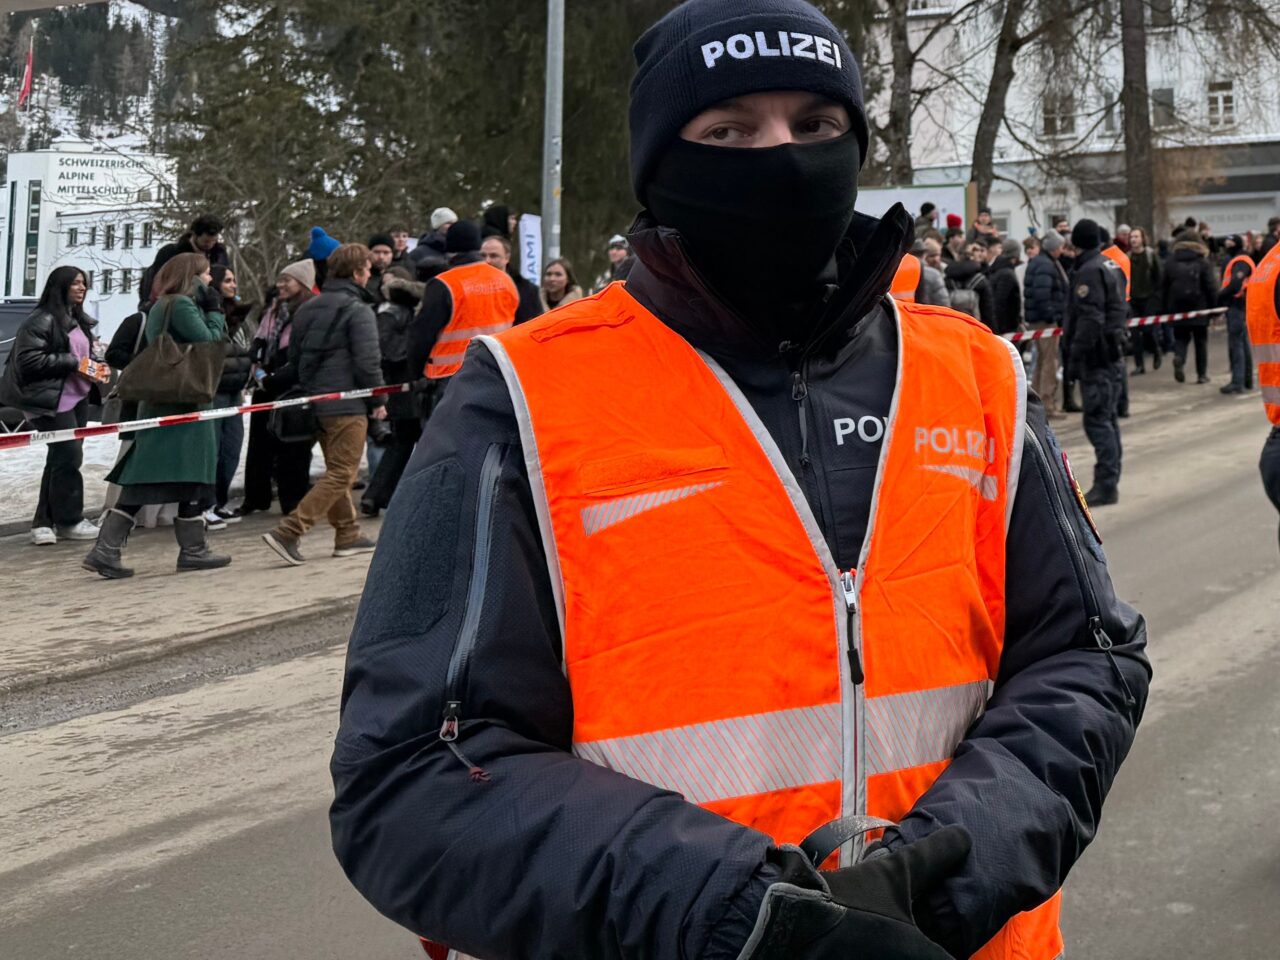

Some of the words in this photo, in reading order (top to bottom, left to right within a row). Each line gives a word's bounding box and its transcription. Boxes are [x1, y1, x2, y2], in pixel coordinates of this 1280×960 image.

[701, 31, 842, 69] POLIZEI
[58, 172, 95, 180] ALPINE
[915, 427, 995, 464] POLIZI
